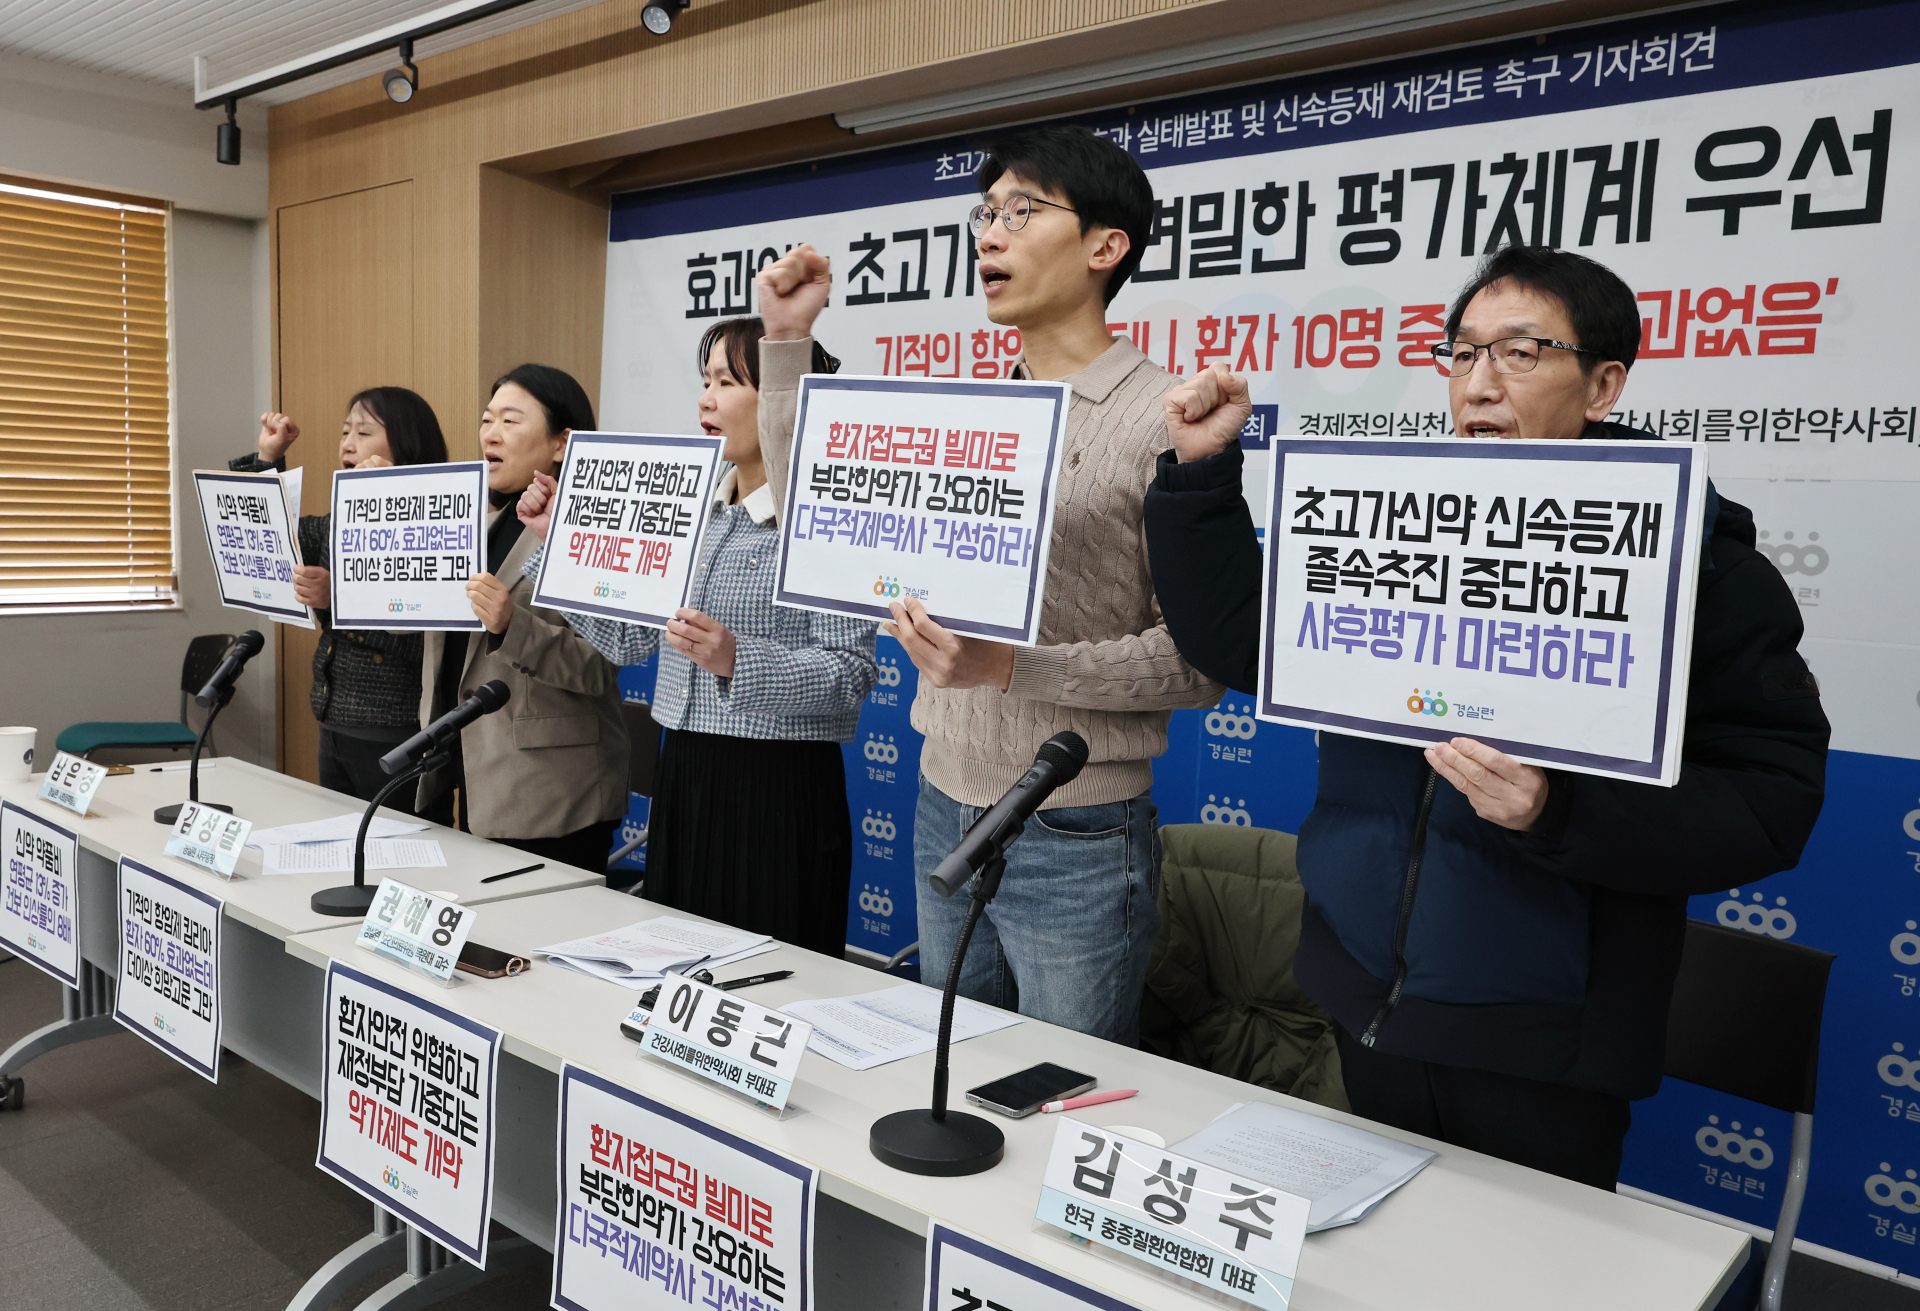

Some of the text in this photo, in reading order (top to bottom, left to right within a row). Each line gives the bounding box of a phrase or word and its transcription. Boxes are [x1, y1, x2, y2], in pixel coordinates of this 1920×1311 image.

[1137, 106, 1234, 154] 실태발표
[1242, 102, 1266, 138] 및
[1273, 82, 1386, 134] 신속등재
[1391, 66, 1486, 116] 재검토
[1492, 53, 1562, 99] 촉구
[1569, 27, 1718, 87] 기자회견
[1336, 138, 1661, 266] 평가체계
[1686, 108, 1893, 236] 우선
[875, 332, 961, 378] 기적의
[1194, 313, 1280, 372] 환자
[1291, 307, 1384, 369] 10명
[826, 421, 1020, 472] 환자접근권 빌미로
[1241, 414, 1265, 441] 최
[1299, 412, 1455, 437] 경제정의실천
[572, 457, 703, 498] 환자안전 위협하고
[809, 463, 1025, 520] 부당한약가 강요하는
[217, 494, 271, 525] 신약 약품비
[344, 493, 472, 523] 기적의 항암제 킴리아
[563, 494, 692, 538] 재정부담 가중되는
[1290, 485, 1663, 559] 초고가신약 신속등재
[217, 524, 246, 550] 연평균
[262, 529, 283, 555] 증가
[341, 524, 473, 553] 환자 60% 효과없는데
[568, 531, 673, 578] 약가제도 개악
[794, 504, 1033, 568] 다국적제약사 각성하라
[219, 551, 241, 575] 건보
[239, 554, 276, 581] 인상률의
[343, 555, 472, 582] 더이상 희망고문 그만
[1305, 545, 1630, 622] 졸속추진 중단하고
[902, 586, 929, 600] 경실련
[1296, 600, 1635, 689] 사후평가 마련하라
[870, 690, 898, 706] 경실련
[1453, 703, 1495, 721] 경실련
[866, 766, 897, 784] 경실련
[1207, 743, 1252, 764] 경실련
[16, 827, 62, 878] 신약 약품비
[864, 842, 894, 860] 경실련
[10, 858, 68, 912] 연평균 13% 증가
[6, 885, 72, 944] 건보 인상률의 8배
[126, 888, 212, 957] 기적의 항암제 킴리아
[861, 917, 891, 937] 경실련
[125, 918, 214, 991] 환자 60% 효과없는데
[434, 955, 450, 972] 교수
[127, 950, 213, 1023] 더이상 희망고문 그만
[338, 995, 480, 1100] 환자안전 위협하고
[650, 1033, 778, 1098] 건강사회를위한약사회 부대표
[337, 1039, 479, 1148] 재정부담 가중되는
[349, 1090, 464, 1190] 약가제도 개악
[590, 1123, 774, 1248] 환자접근권 빌미로
[1698, 1163, 1765, 1199] 경실련
[569, 1202, 696, 1305] 다국적제약사
[579, 1163, 786, 1304] 부당한약가 강요하는
[1064, 1202, 1258, 1294] 한국 중증질환연합회 대표
